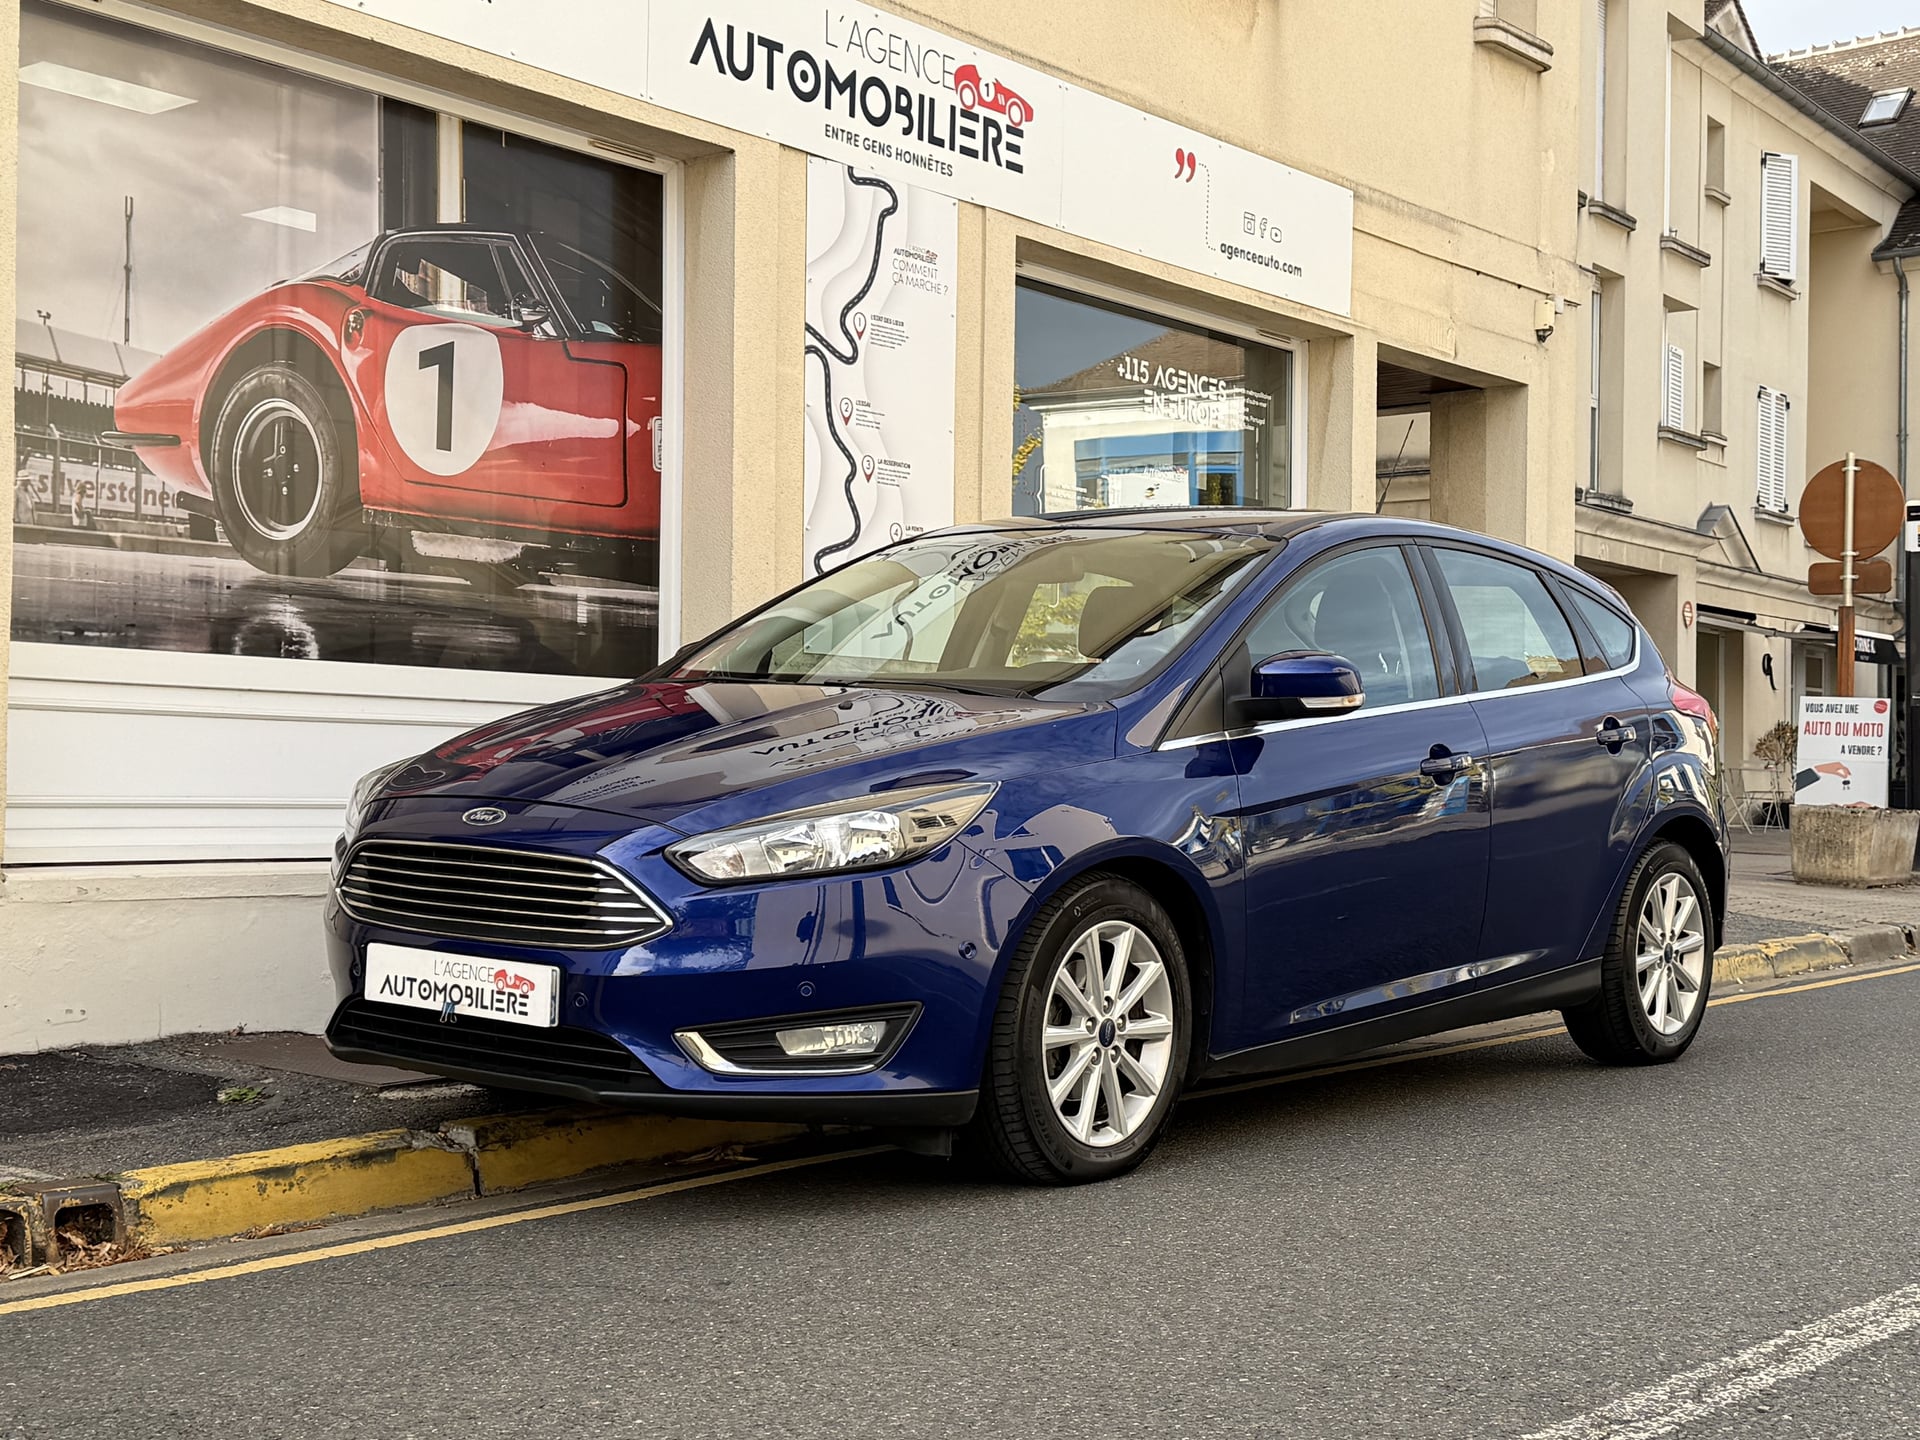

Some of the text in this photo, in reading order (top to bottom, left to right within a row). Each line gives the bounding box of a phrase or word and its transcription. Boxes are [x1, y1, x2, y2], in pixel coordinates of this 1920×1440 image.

[825, 9, 956, 91] L'AGENCE
[689, 17, 1025, 174] AUTOMOBILIERE
[824, 123, 953, 178] ENTRE GENS HONNÊTES
[892, 258, 938, 280] COMMENT
[1220, 241, 1302, 278] agenceauto.com
[905, 274, 942, 294] MARCHE
[418, 340, 455, 452] 1
[1117, 355, 1150, 384] +115
[1153, 364, 1227, 401] AGENCES
[1805, 703, 1859, 714] VOUS AVEZ UNE
[1803, 720, 1884, 738] AUTO OU MOTO
[1840, 744, 1883, 756] A VENDRE ?
[433, 959, 495, 984] L'AGENCE
[380, 974, 530, 1017] AUTOMOBILIERE
